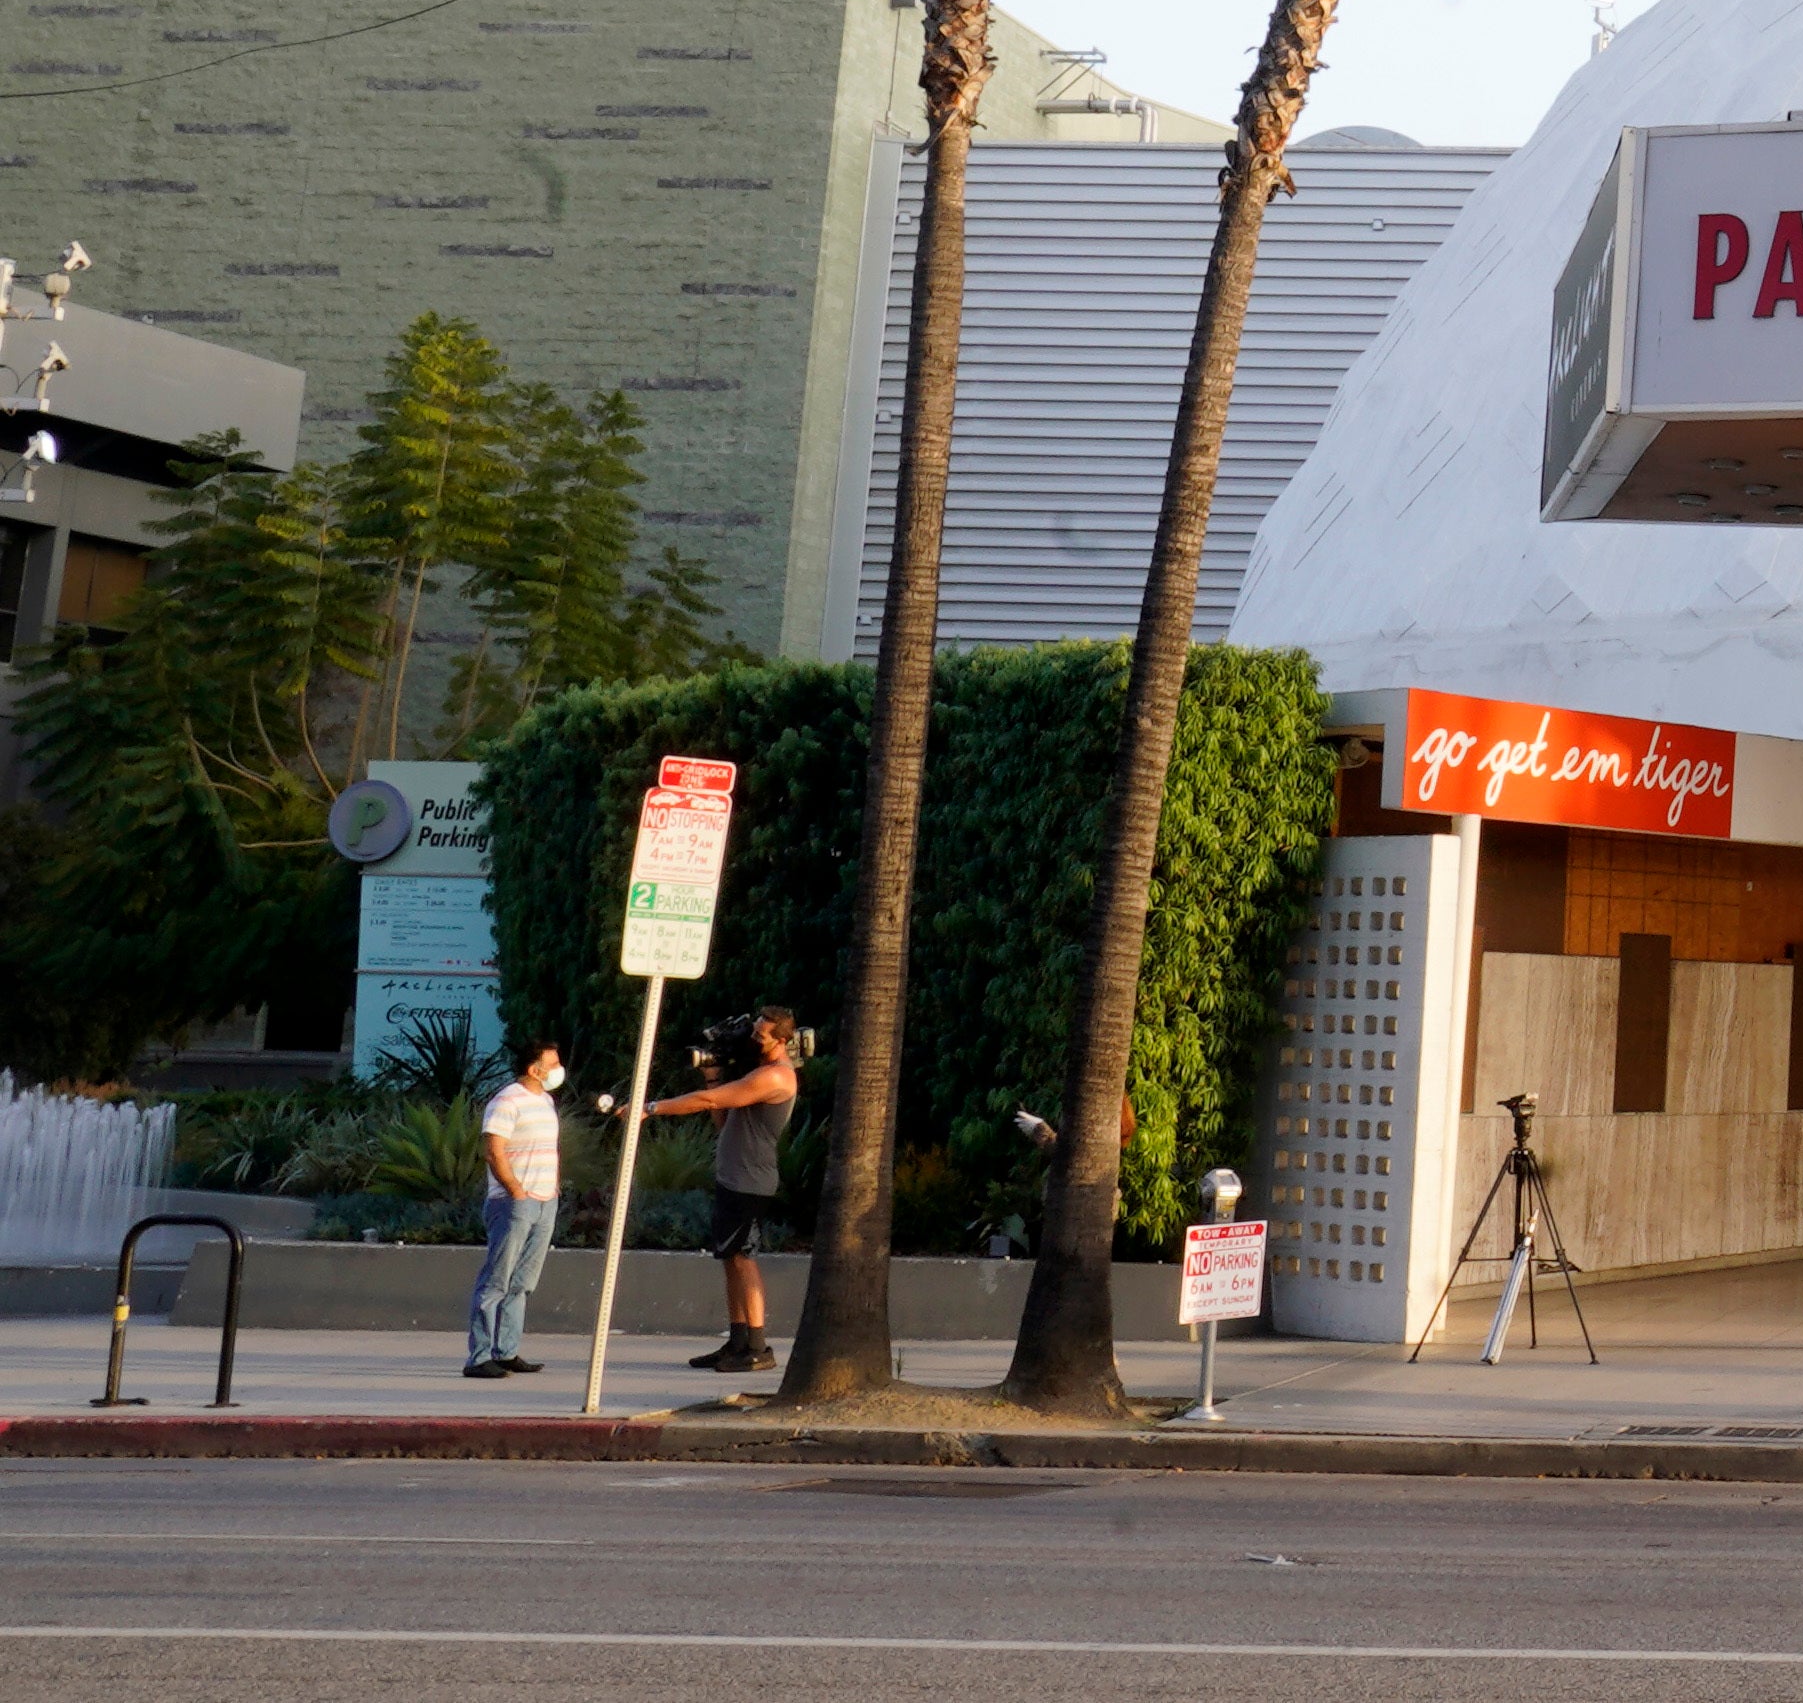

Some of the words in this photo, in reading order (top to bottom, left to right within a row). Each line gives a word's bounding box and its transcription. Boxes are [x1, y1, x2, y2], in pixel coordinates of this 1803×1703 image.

[1411, 727, 1477, 802] go
[1477, 711, 1551, 807] get
[1551, 745, 1629, 788] em
[1632, 724, 1730, 828] tiger
[420, 798, 479, 820] Public
[644, 807, 669, 829] NO
[669, 811, 725, 832] STOPPING
[417, 825, 489, 853] Parking
[634, 883, 653, 908] 2
[655, 894, 711, 914] PARKING
[1188, 1252, 1211, 1275] NO
[1213, 1252, 1259, 1272] PARKING
